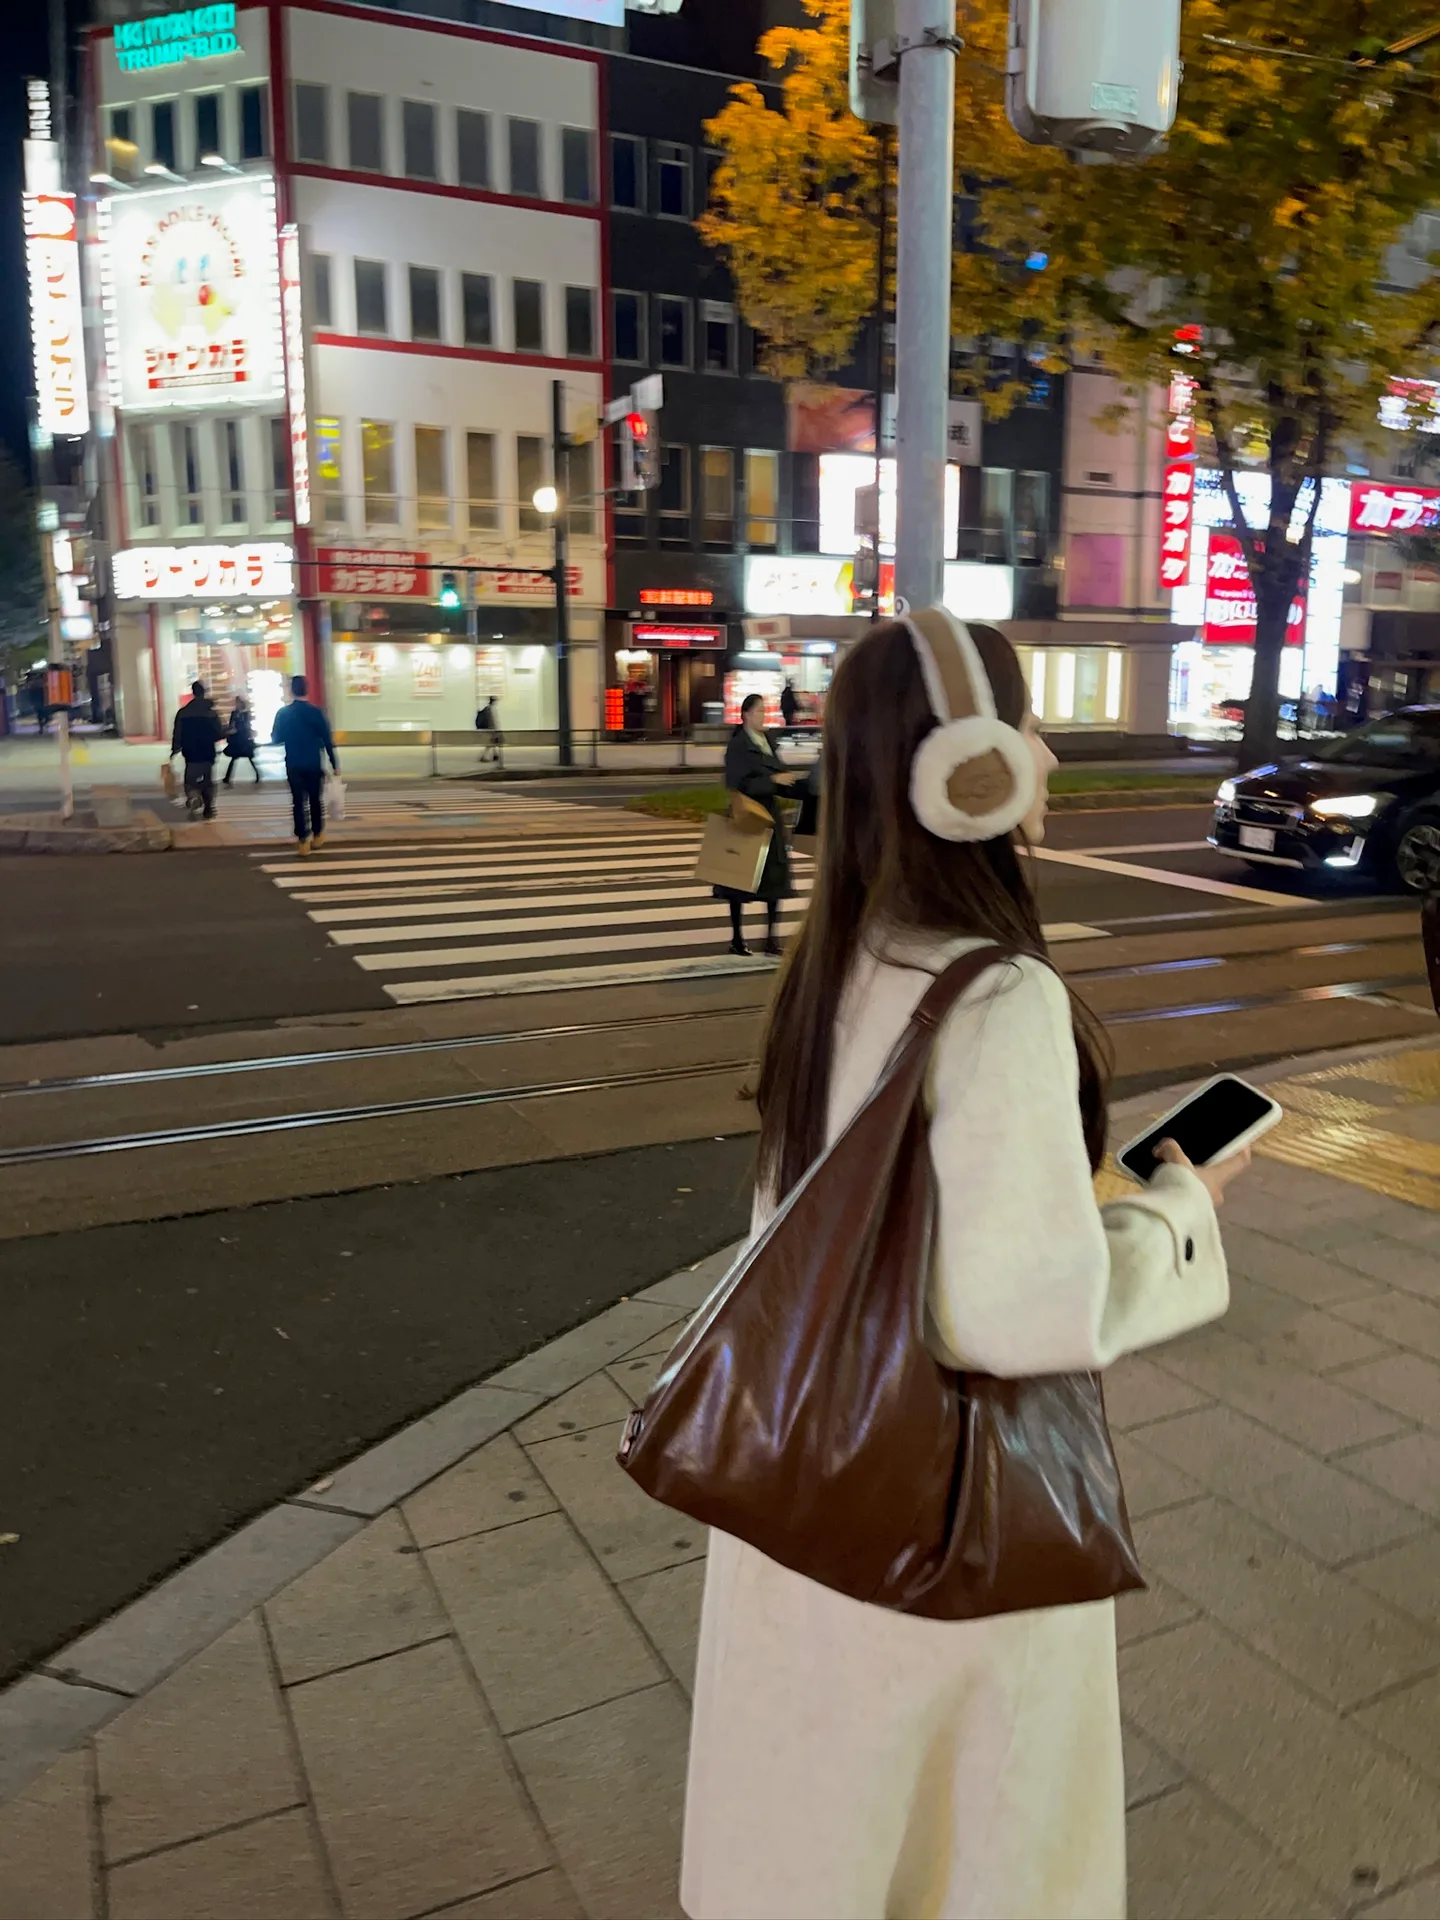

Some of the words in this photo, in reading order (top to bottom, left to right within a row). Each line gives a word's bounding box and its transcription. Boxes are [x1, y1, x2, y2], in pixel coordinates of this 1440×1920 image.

[1161, 471, 1192, 580] カラオケ
[330, 569, 417, 593] カラオケ
